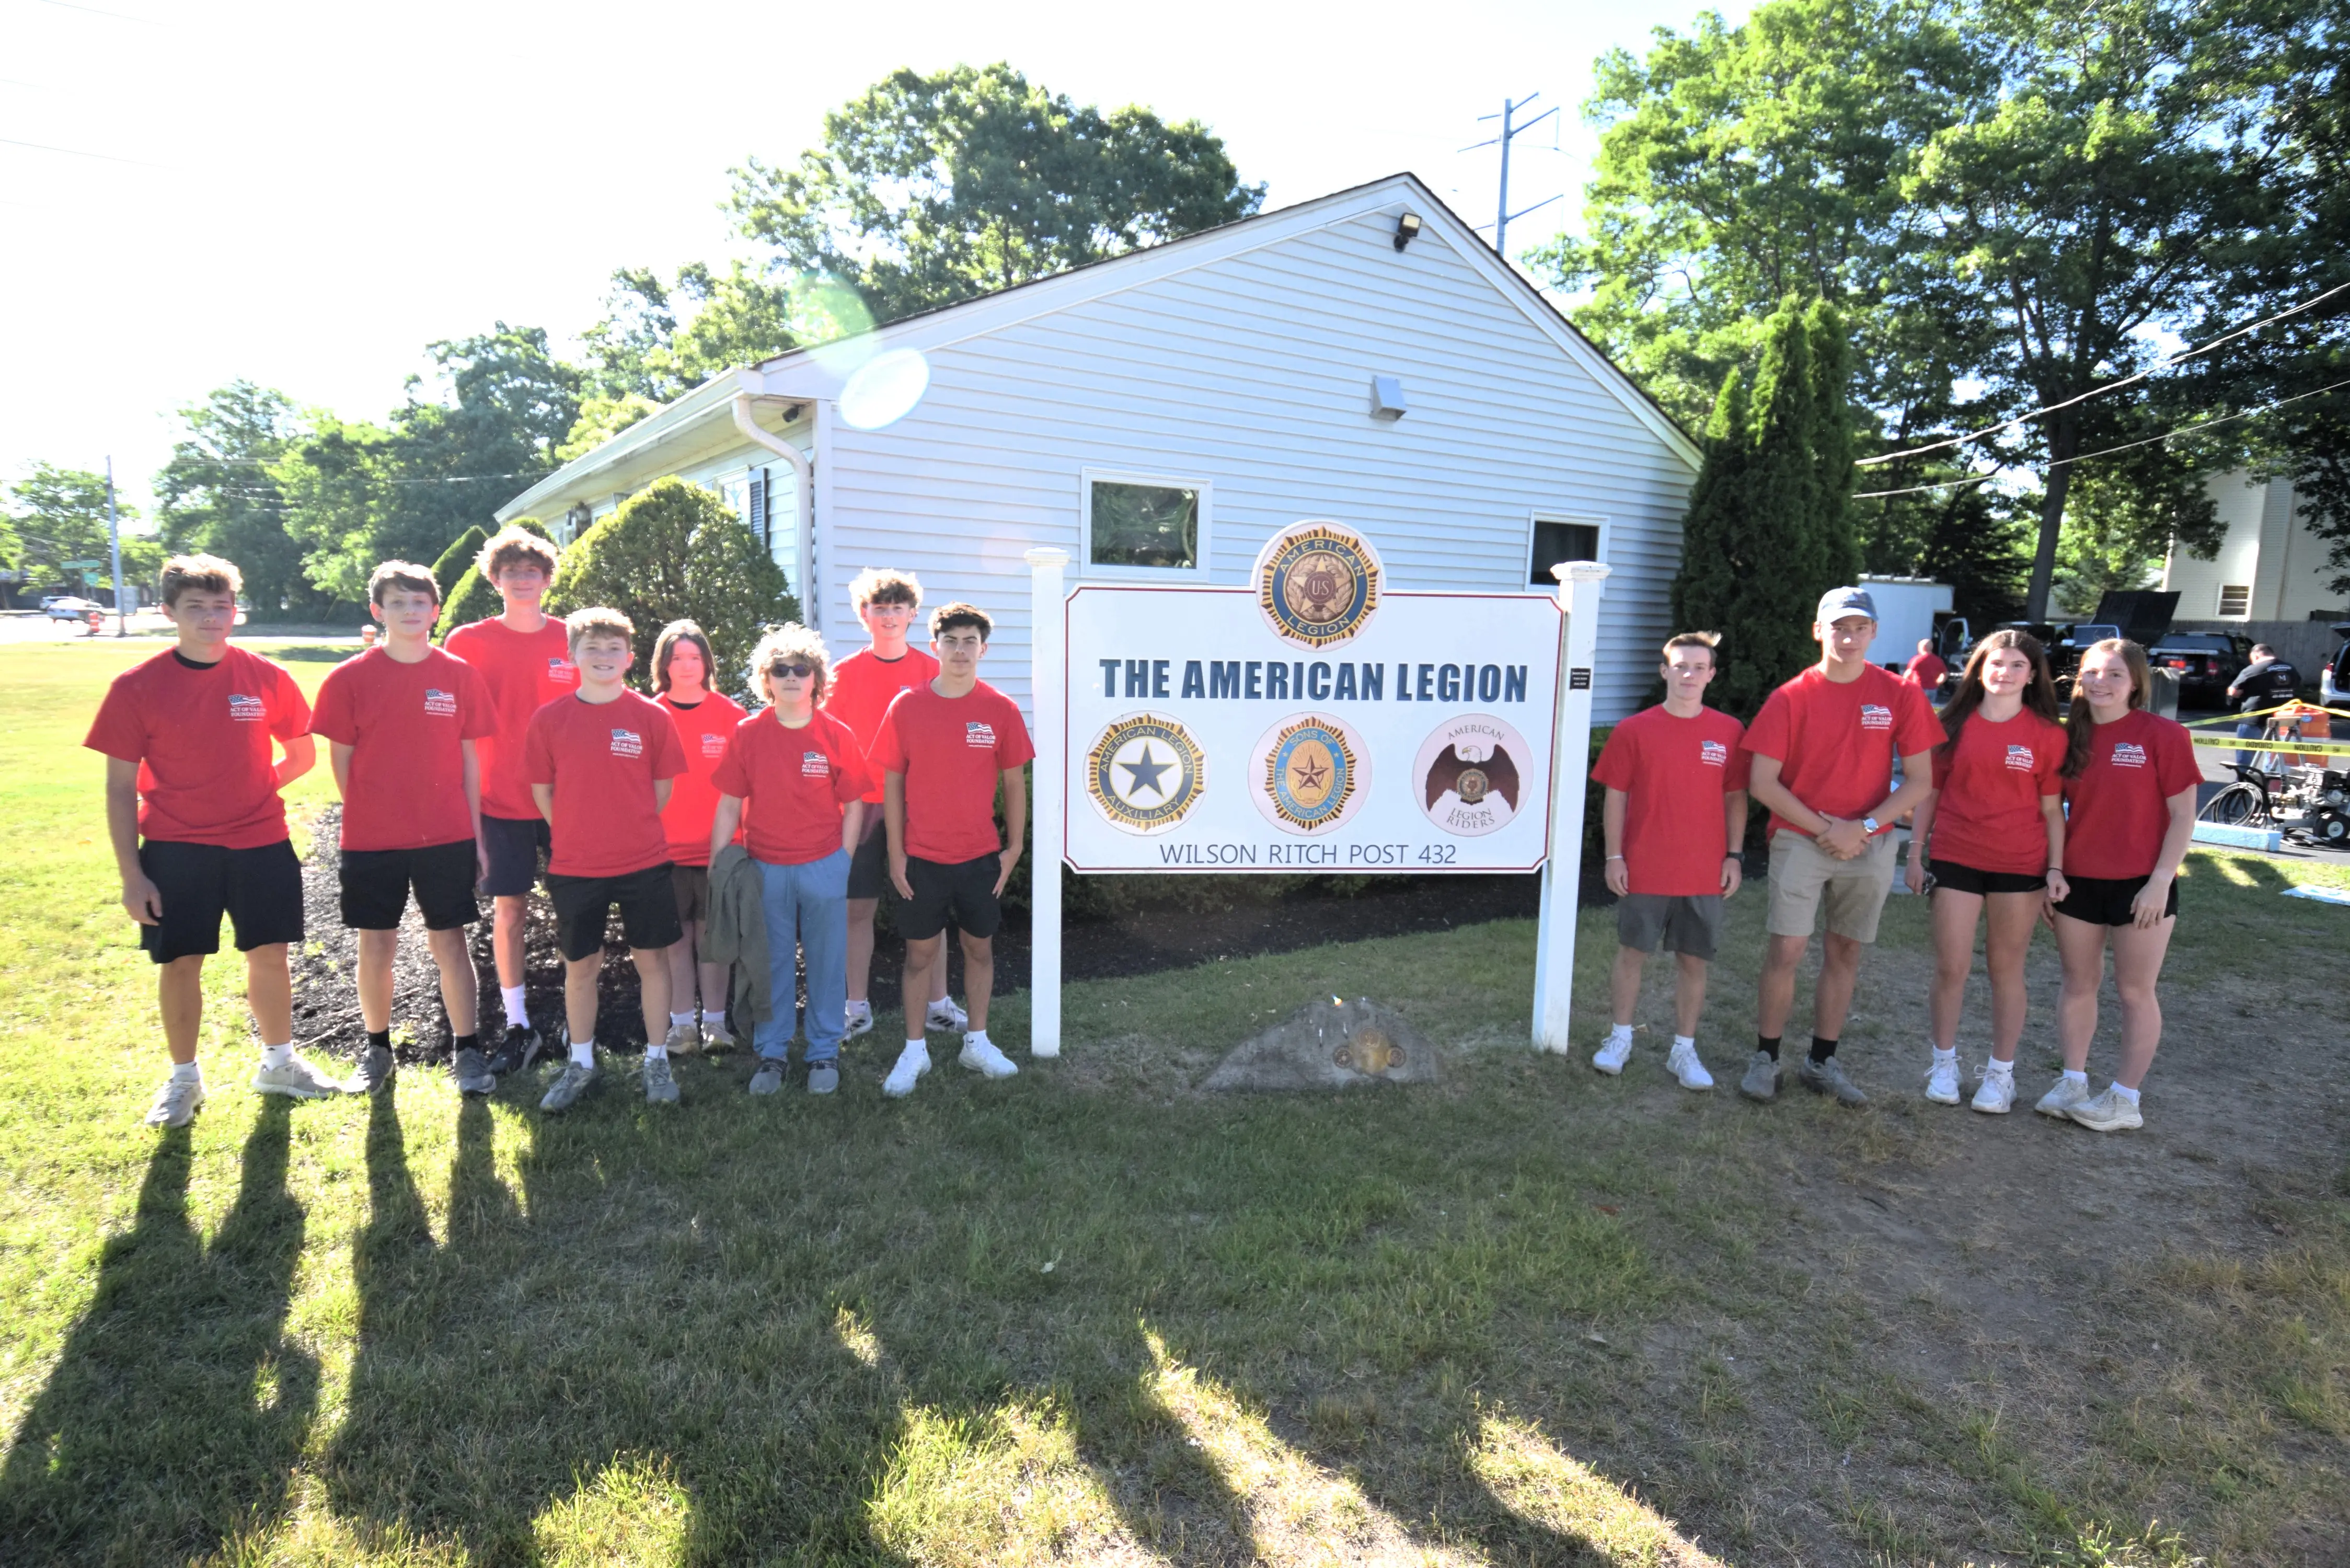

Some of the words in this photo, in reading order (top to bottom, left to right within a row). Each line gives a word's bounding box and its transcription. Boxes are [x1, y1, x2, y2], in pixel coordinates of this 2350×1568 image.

[1281, 540, 1365, 577] AMERICAN
[1287, 616, 1350, 635] LEGION
[1099, 659, 1170, 698] THE
[1181, 660, 1384, 701] AMERICAN
[1397, 663, 1528, 702] LEGION
[1289, 731, 1318, 746] SONS
[1321, 734, 1335, 744] OF
[1448, 724, 1505, 741] AMERICAN
[610, 746, 641, 754] FOUNDATION
[2194, 737, 2220, 746] CAUTION
[2245, 741, 2273, 750] CUIDADO
[2294, 744, 2322, 752] CAUTION
[1100, 727, 1156, 773] AMERICAN
[1160, 730, 1193, 774] LEGION
[1276, 766, 1284, 787] THE
[1280, 791, 1329, 818] AMERICAN
[1328, 768, 1344, 805] LEGION
[1107, 795, 1181, 820] AUXILIARY
[1451, 808, 1491, 820] LEGION
[1446, 816, 1495, 828] RIDERS
[1159, 844, 1256, 864] WILSON
[1269, 844, 1338, 864] RITCH
[1350, 844, 1409, 864] POST
[1418, 844, 1457, 864] 432
